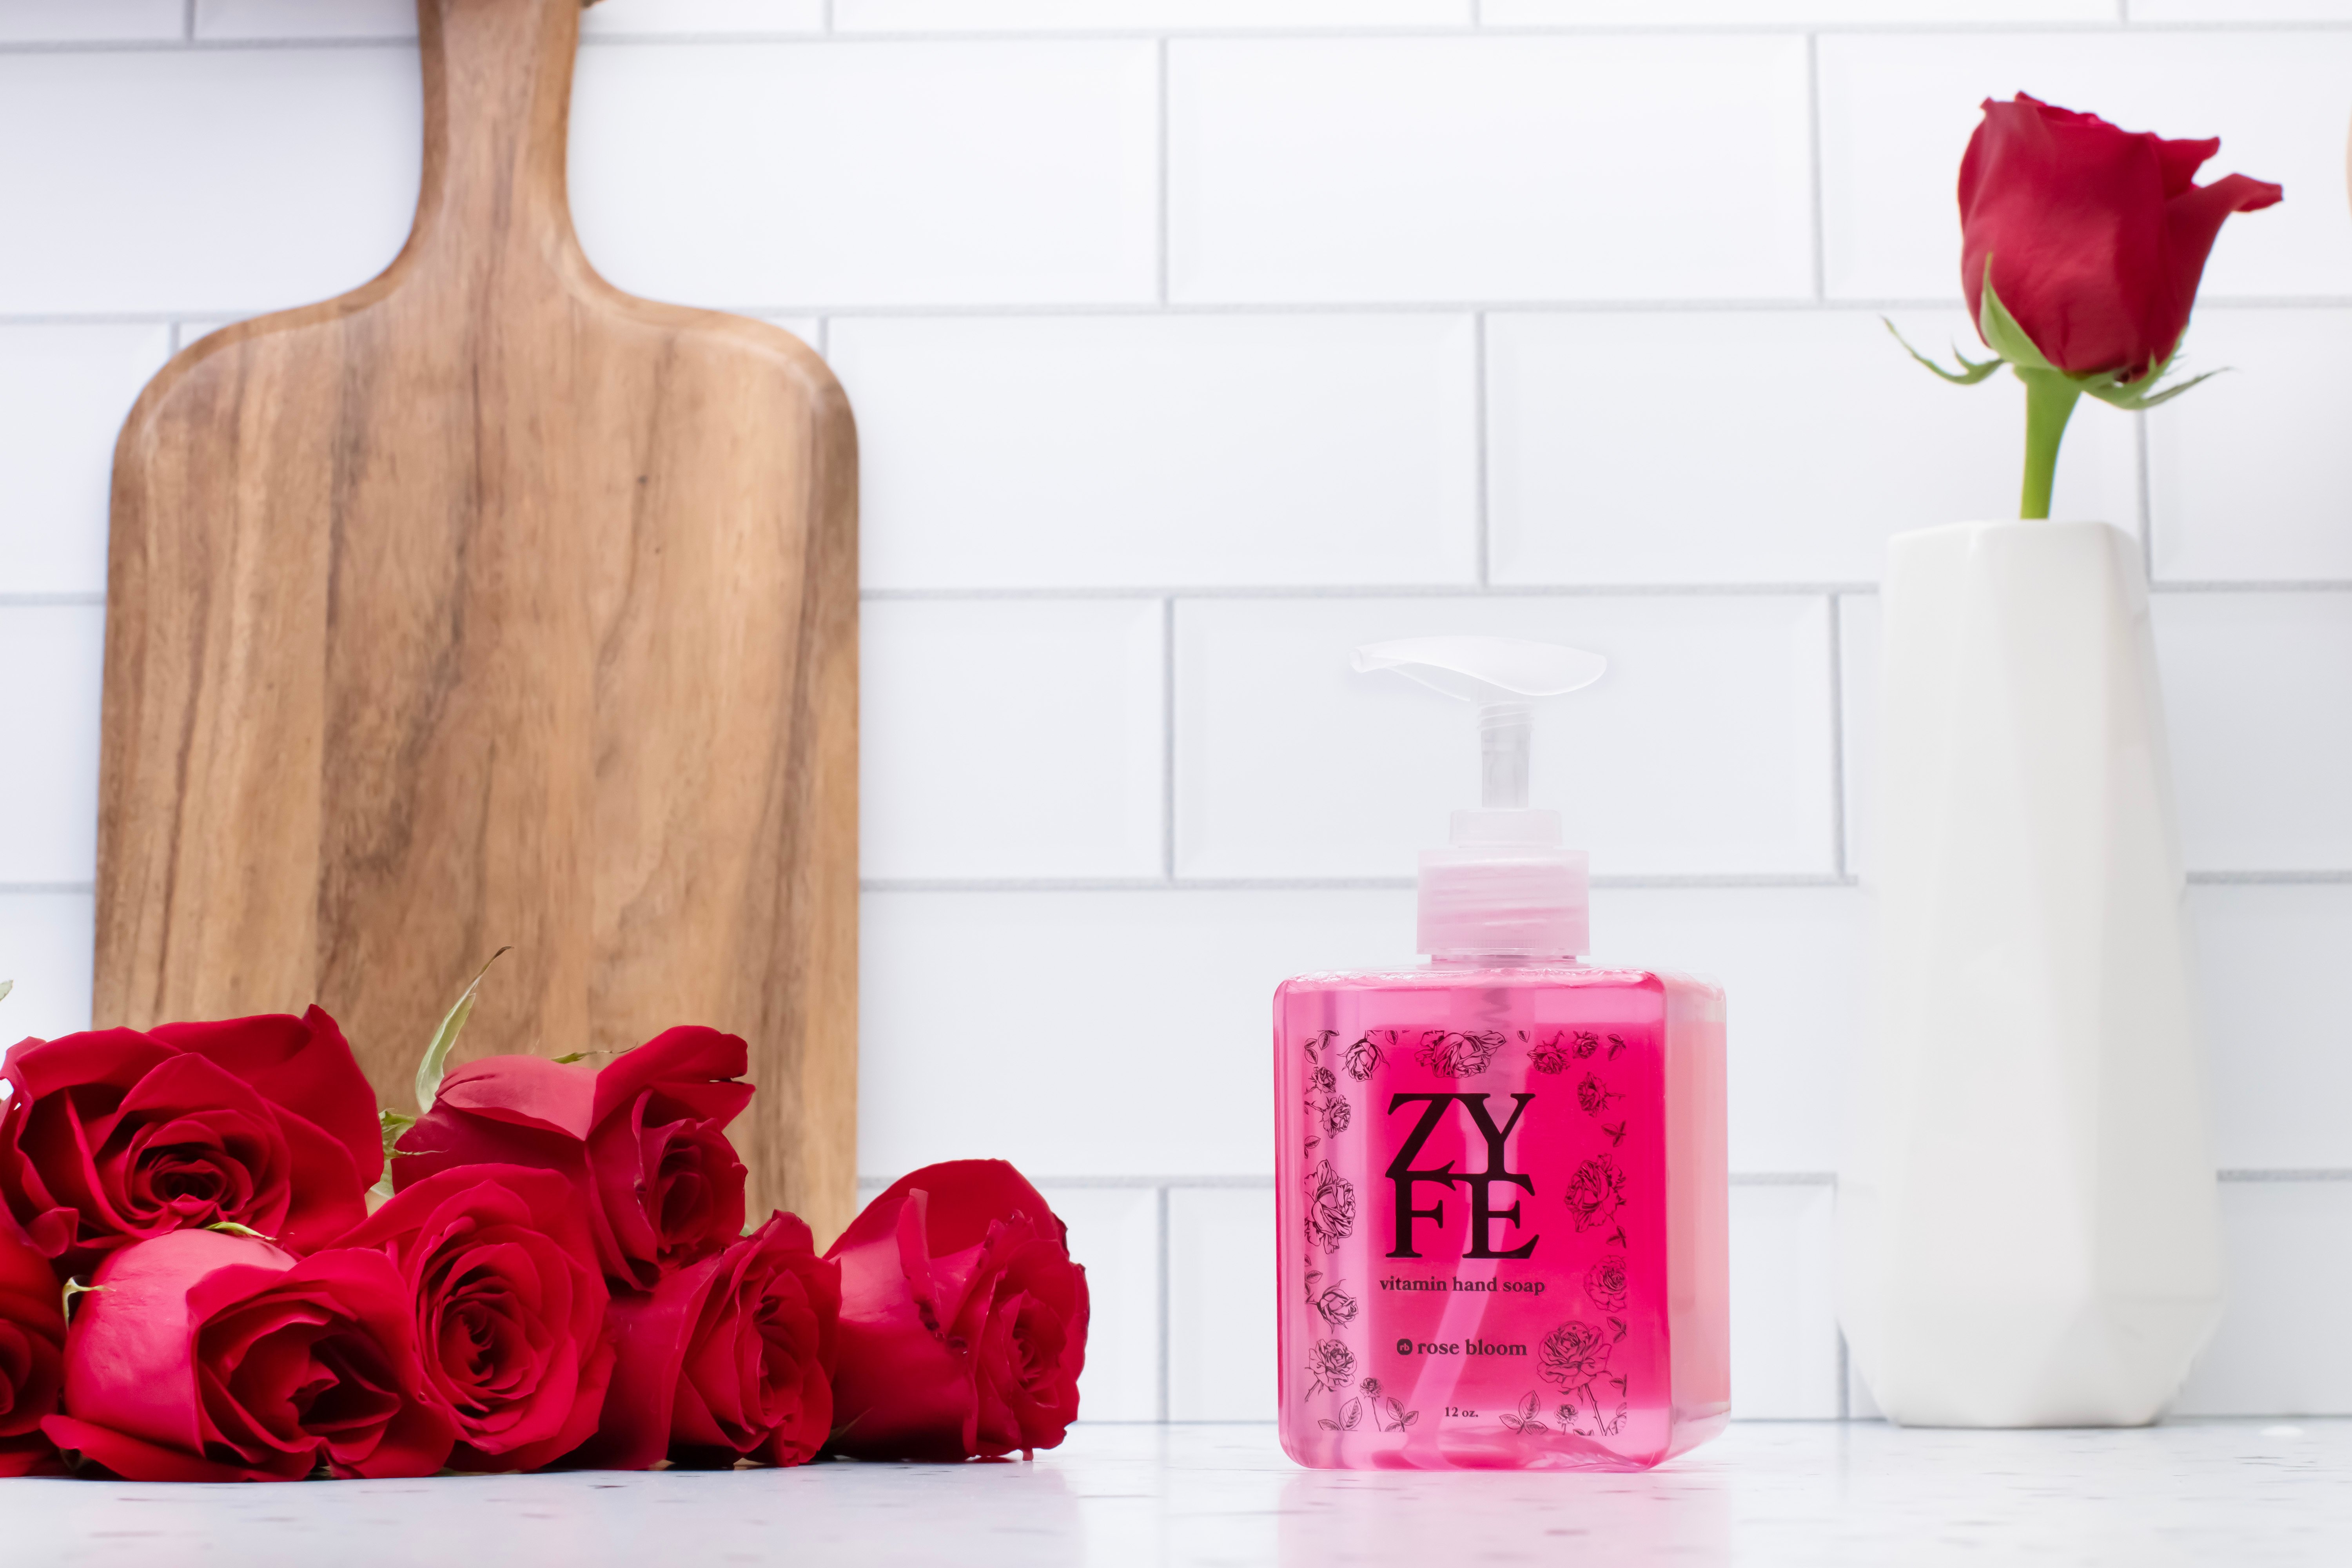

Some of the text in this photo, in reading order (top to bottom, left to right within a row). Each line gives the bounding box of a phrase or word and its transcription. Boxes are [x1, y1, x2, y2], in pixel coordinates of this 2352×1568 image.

[1385, 1093, 1536, 1178] ZY
[1385, 1174, 1540, 1259] FE
[1379, 1276, 1545, 1296] vitamin hand soap
[1417, 1343, 1459, 1355] rose
[1465, 1338, 1527, 1356] bloom
[1445, 1406, 1458, 1417] 12
